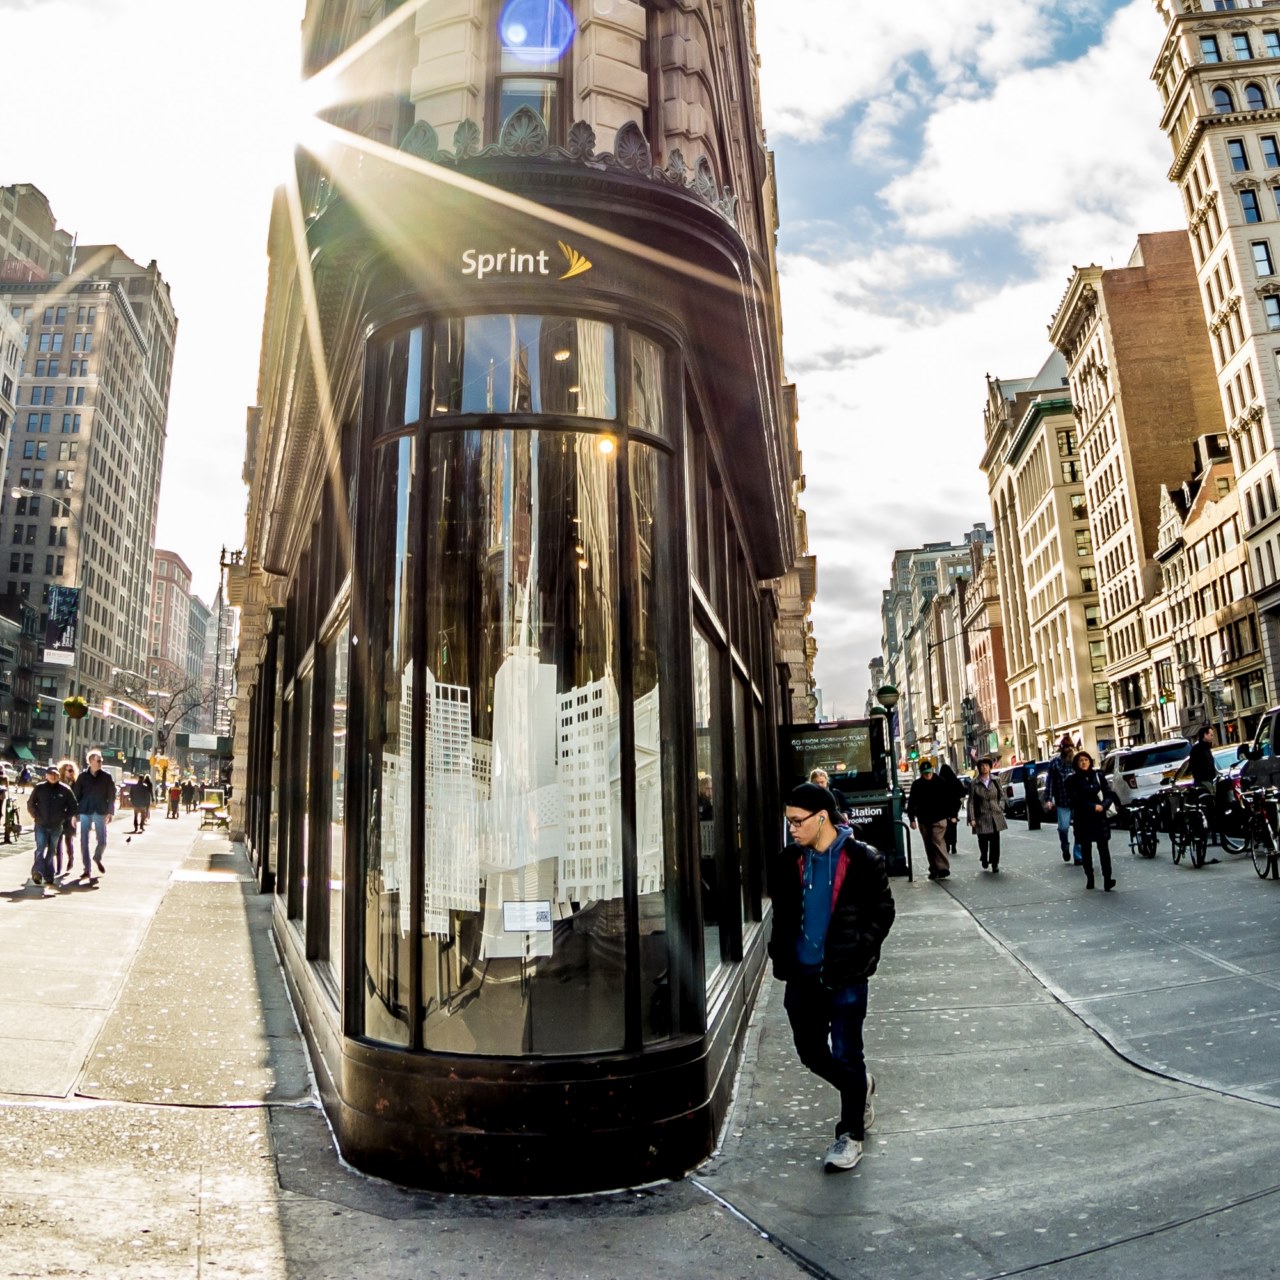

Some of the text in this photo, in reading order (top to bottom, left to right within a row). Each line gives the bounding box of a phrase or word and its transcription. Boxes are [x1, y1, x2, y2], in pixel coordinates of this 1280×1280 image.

[462, 248, 549, 279] Sprint
[820, 736, 848, 744] MORNING
[851, 807, 882, 817] Station
[848, 817, 873, 825] rooklyn
